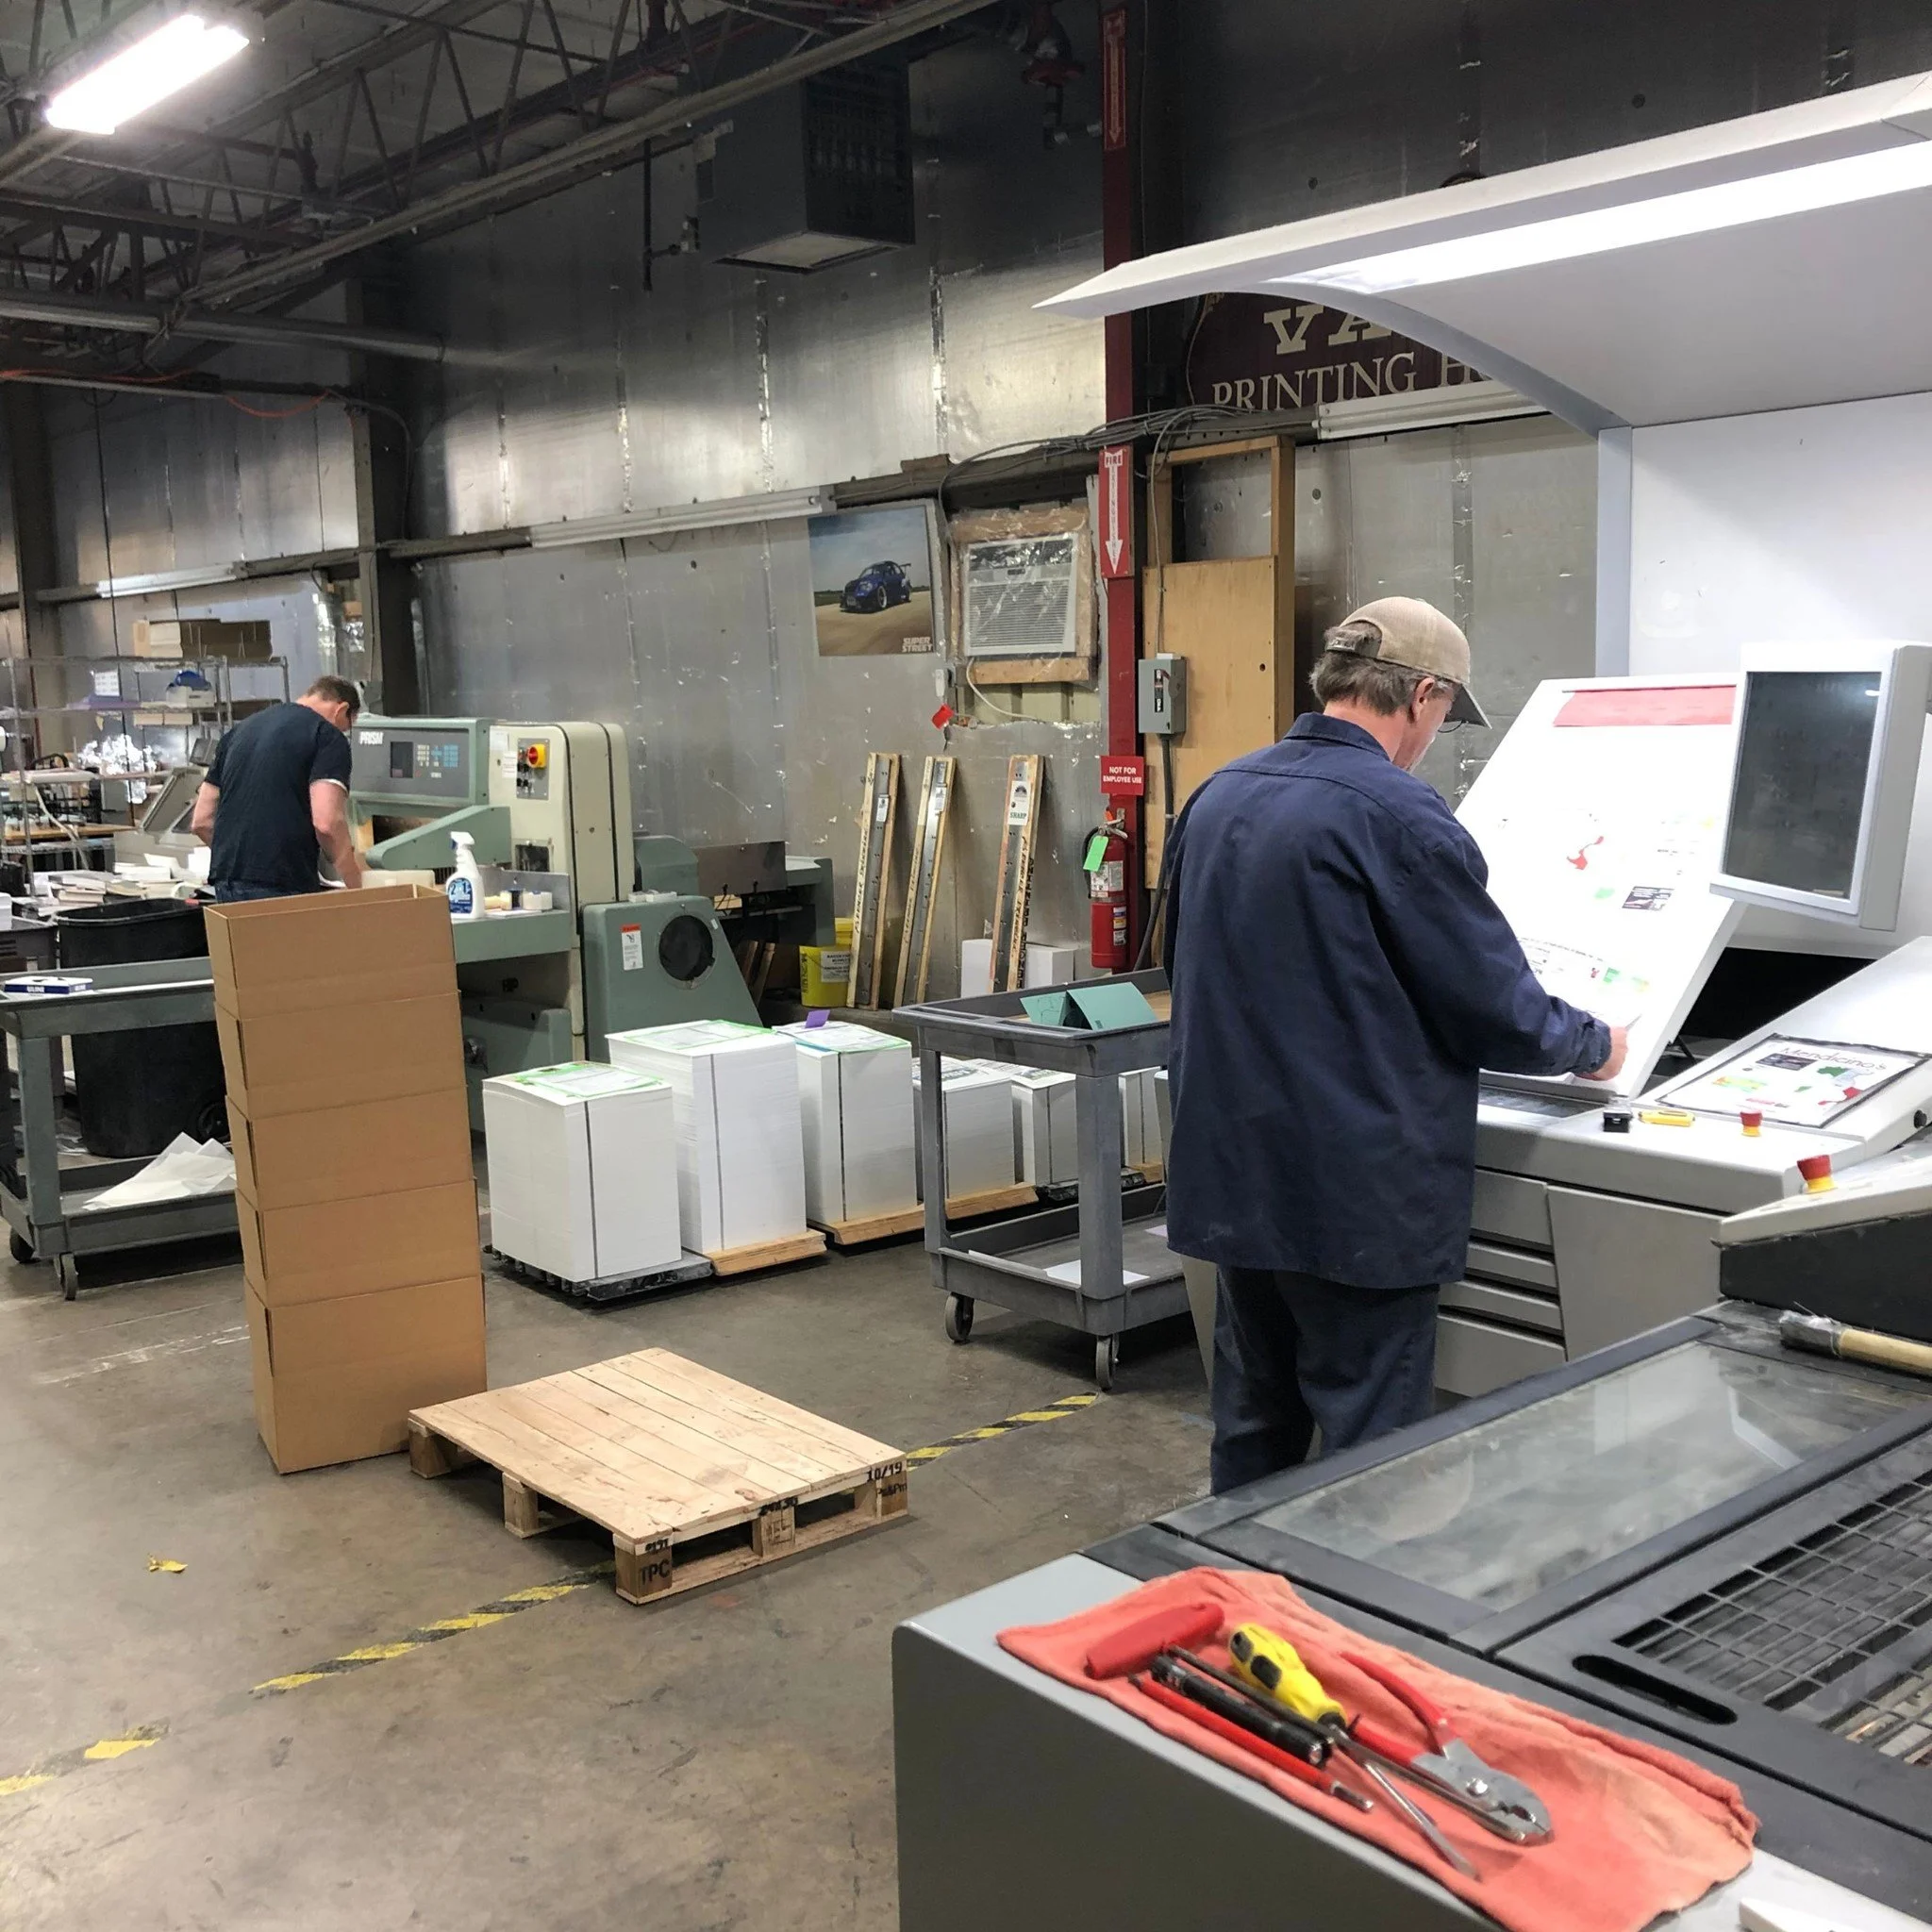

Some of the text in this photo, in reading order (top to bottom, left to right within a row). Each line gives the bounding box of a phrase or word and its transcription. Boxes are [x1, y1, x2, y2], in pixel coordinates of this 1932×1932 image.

[1211, 351, 1492, 409] PRINTING H
[1106, 455, 1122, 464] FIRE
[865, 1461, 903, 1482] 10/19
[641, 1558, 670, 1585] TPC
